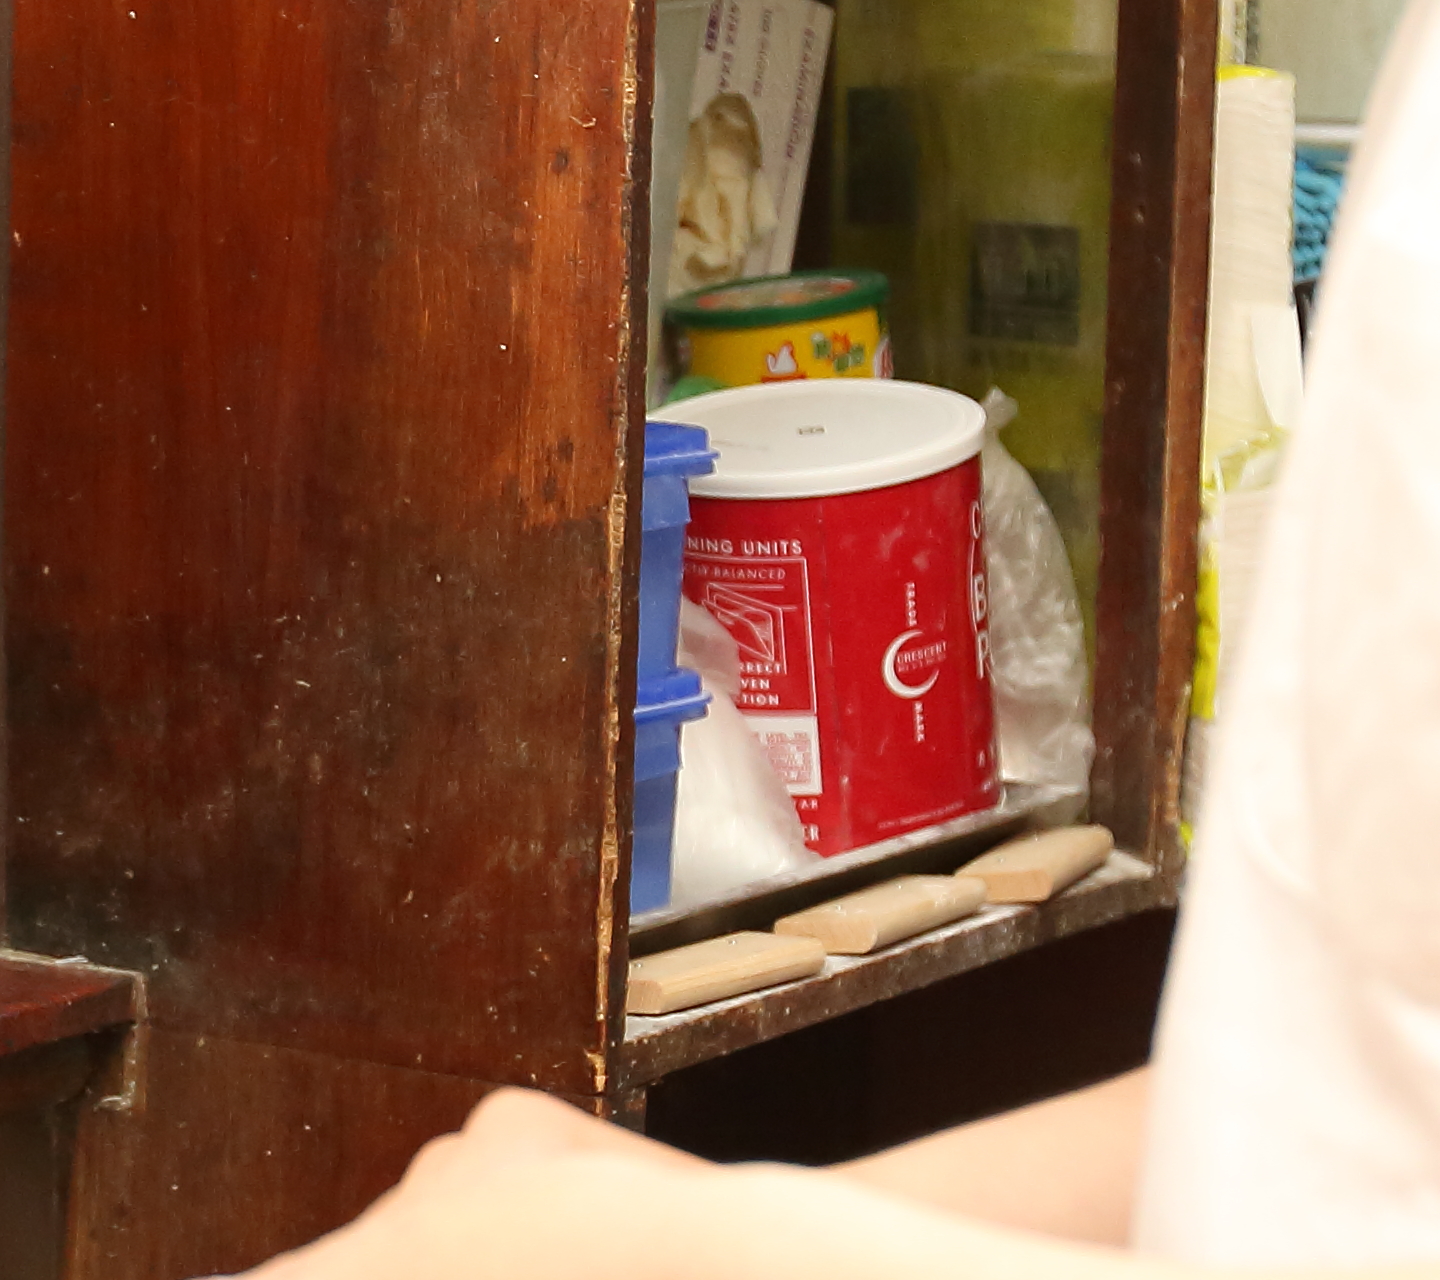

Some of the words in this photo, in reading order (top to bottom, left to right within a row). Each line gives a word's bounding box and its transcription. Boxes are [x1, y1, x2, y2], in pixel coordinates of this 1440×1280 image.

[686, 537, 734, 554] NING
[742, 539, 803, 556] UNITS
[713, 567, 787, 581] BALANCED
[739, 677, 770, 690] VEN
[737, 693, 780, 707] TION
